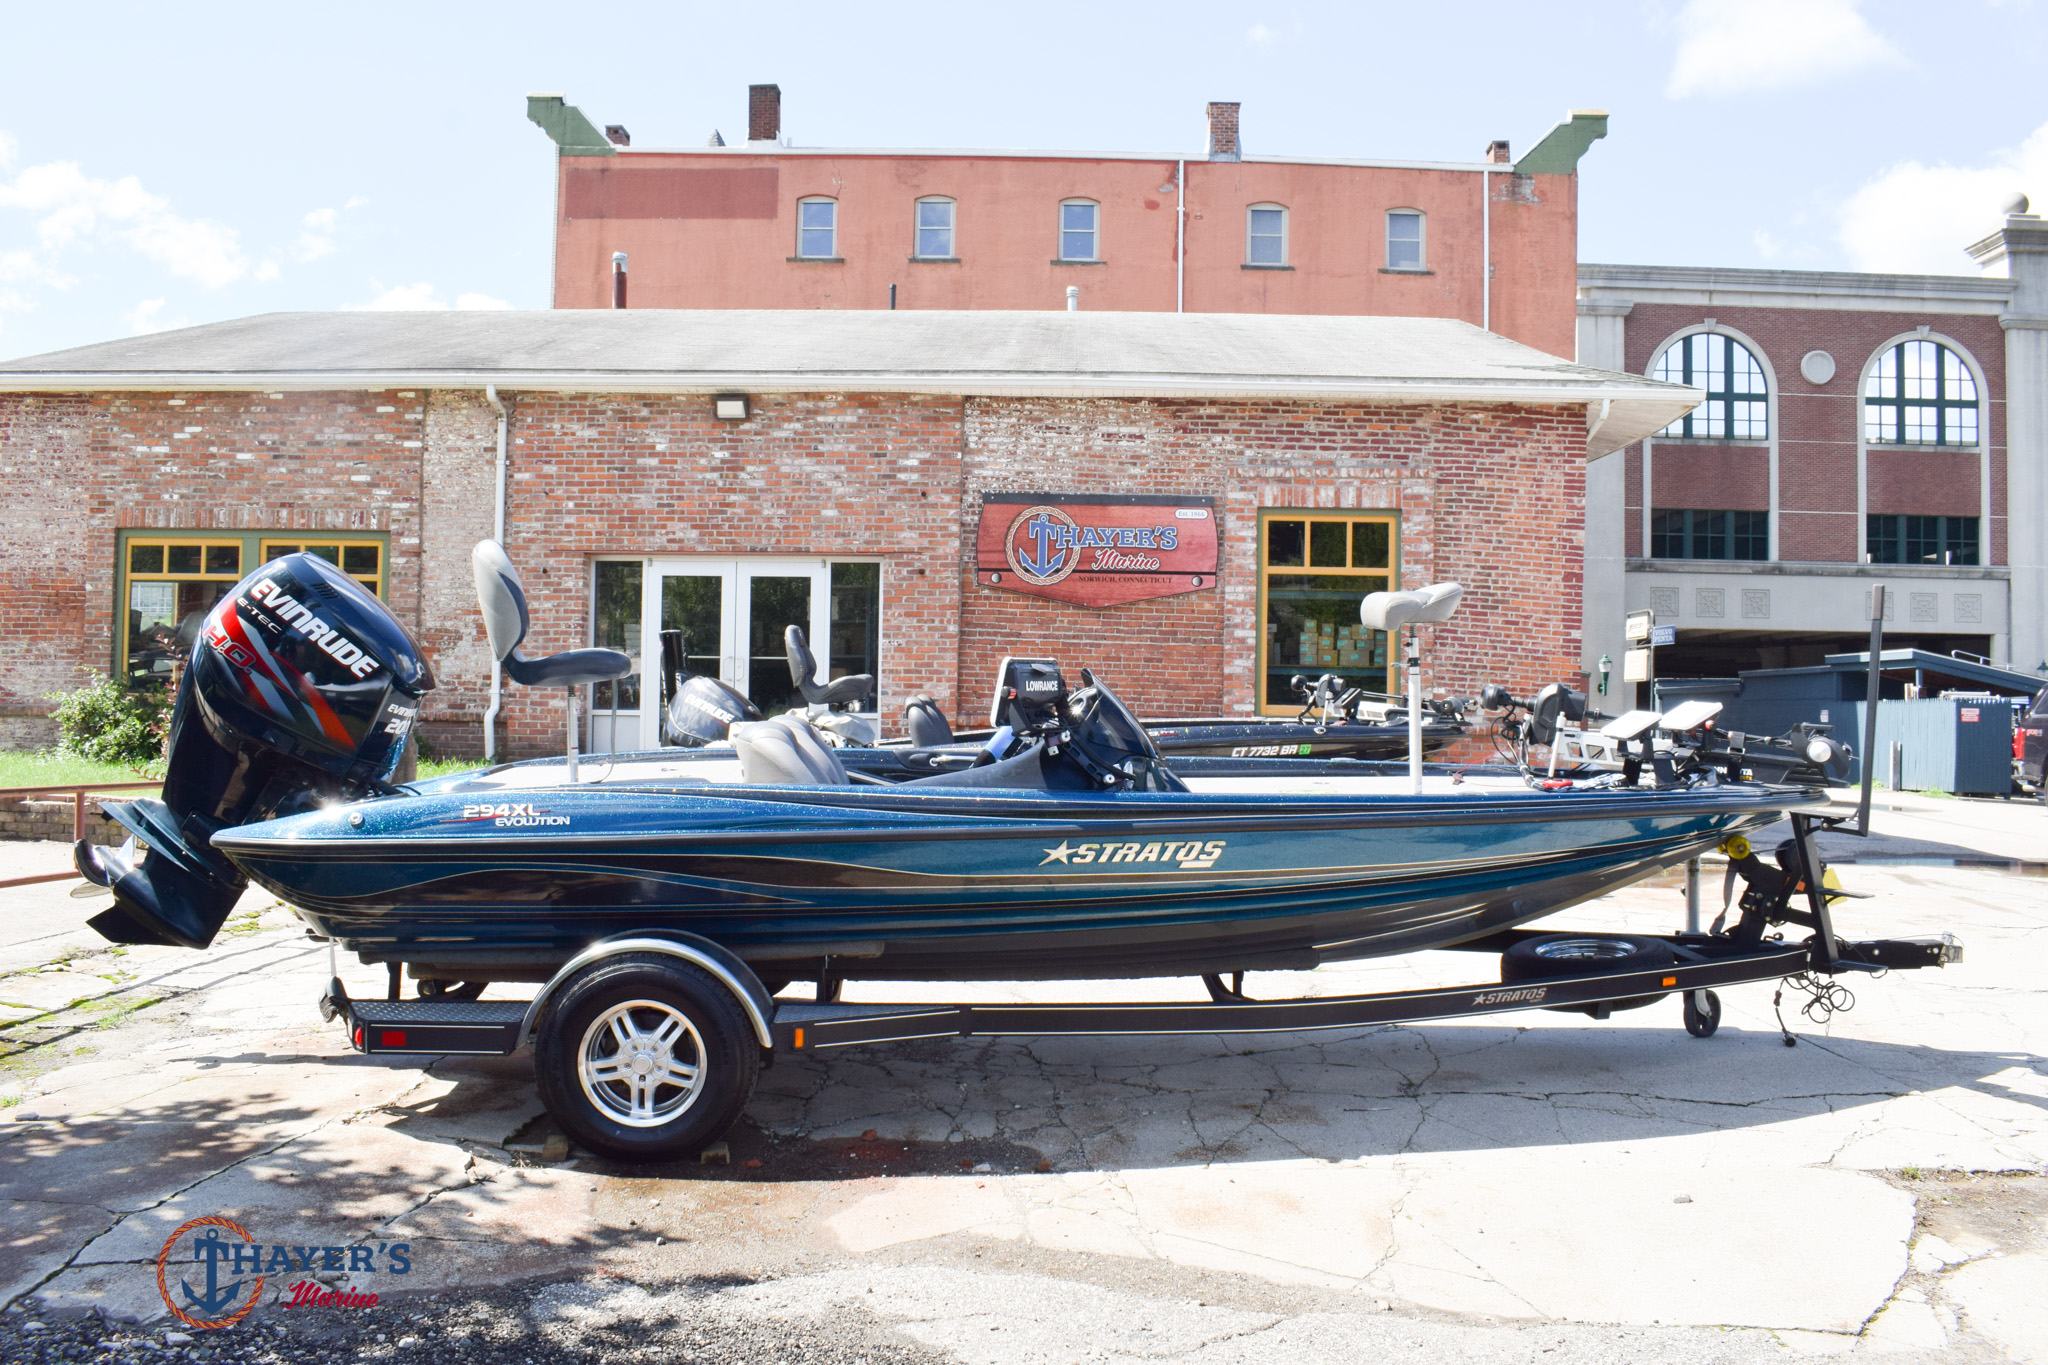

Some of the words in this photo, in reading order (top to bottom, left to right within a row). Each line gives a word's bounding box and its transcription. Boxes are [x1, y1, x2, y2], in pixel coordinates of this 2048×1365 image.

[1091, 549, 1161, 570] Marine
[1118, 576, 1173, 584] CONNECTICUT
[236, 597, 282, 634] E-TEC
[250, 578, 380, 680] EVINRUDE
[1025, 680, 1059, 692] LOWRANCE
[1231, 746, 1248, 758] CT
[1248, 746, 1279, 757] 7732
[462, 803, 541, 819] 294XL
[494, 816, 571, 827] EVOLUTION
[1071, 840, 1227, 868] STRATOS
[1485, 987, 1548, 1004] STRATOS
